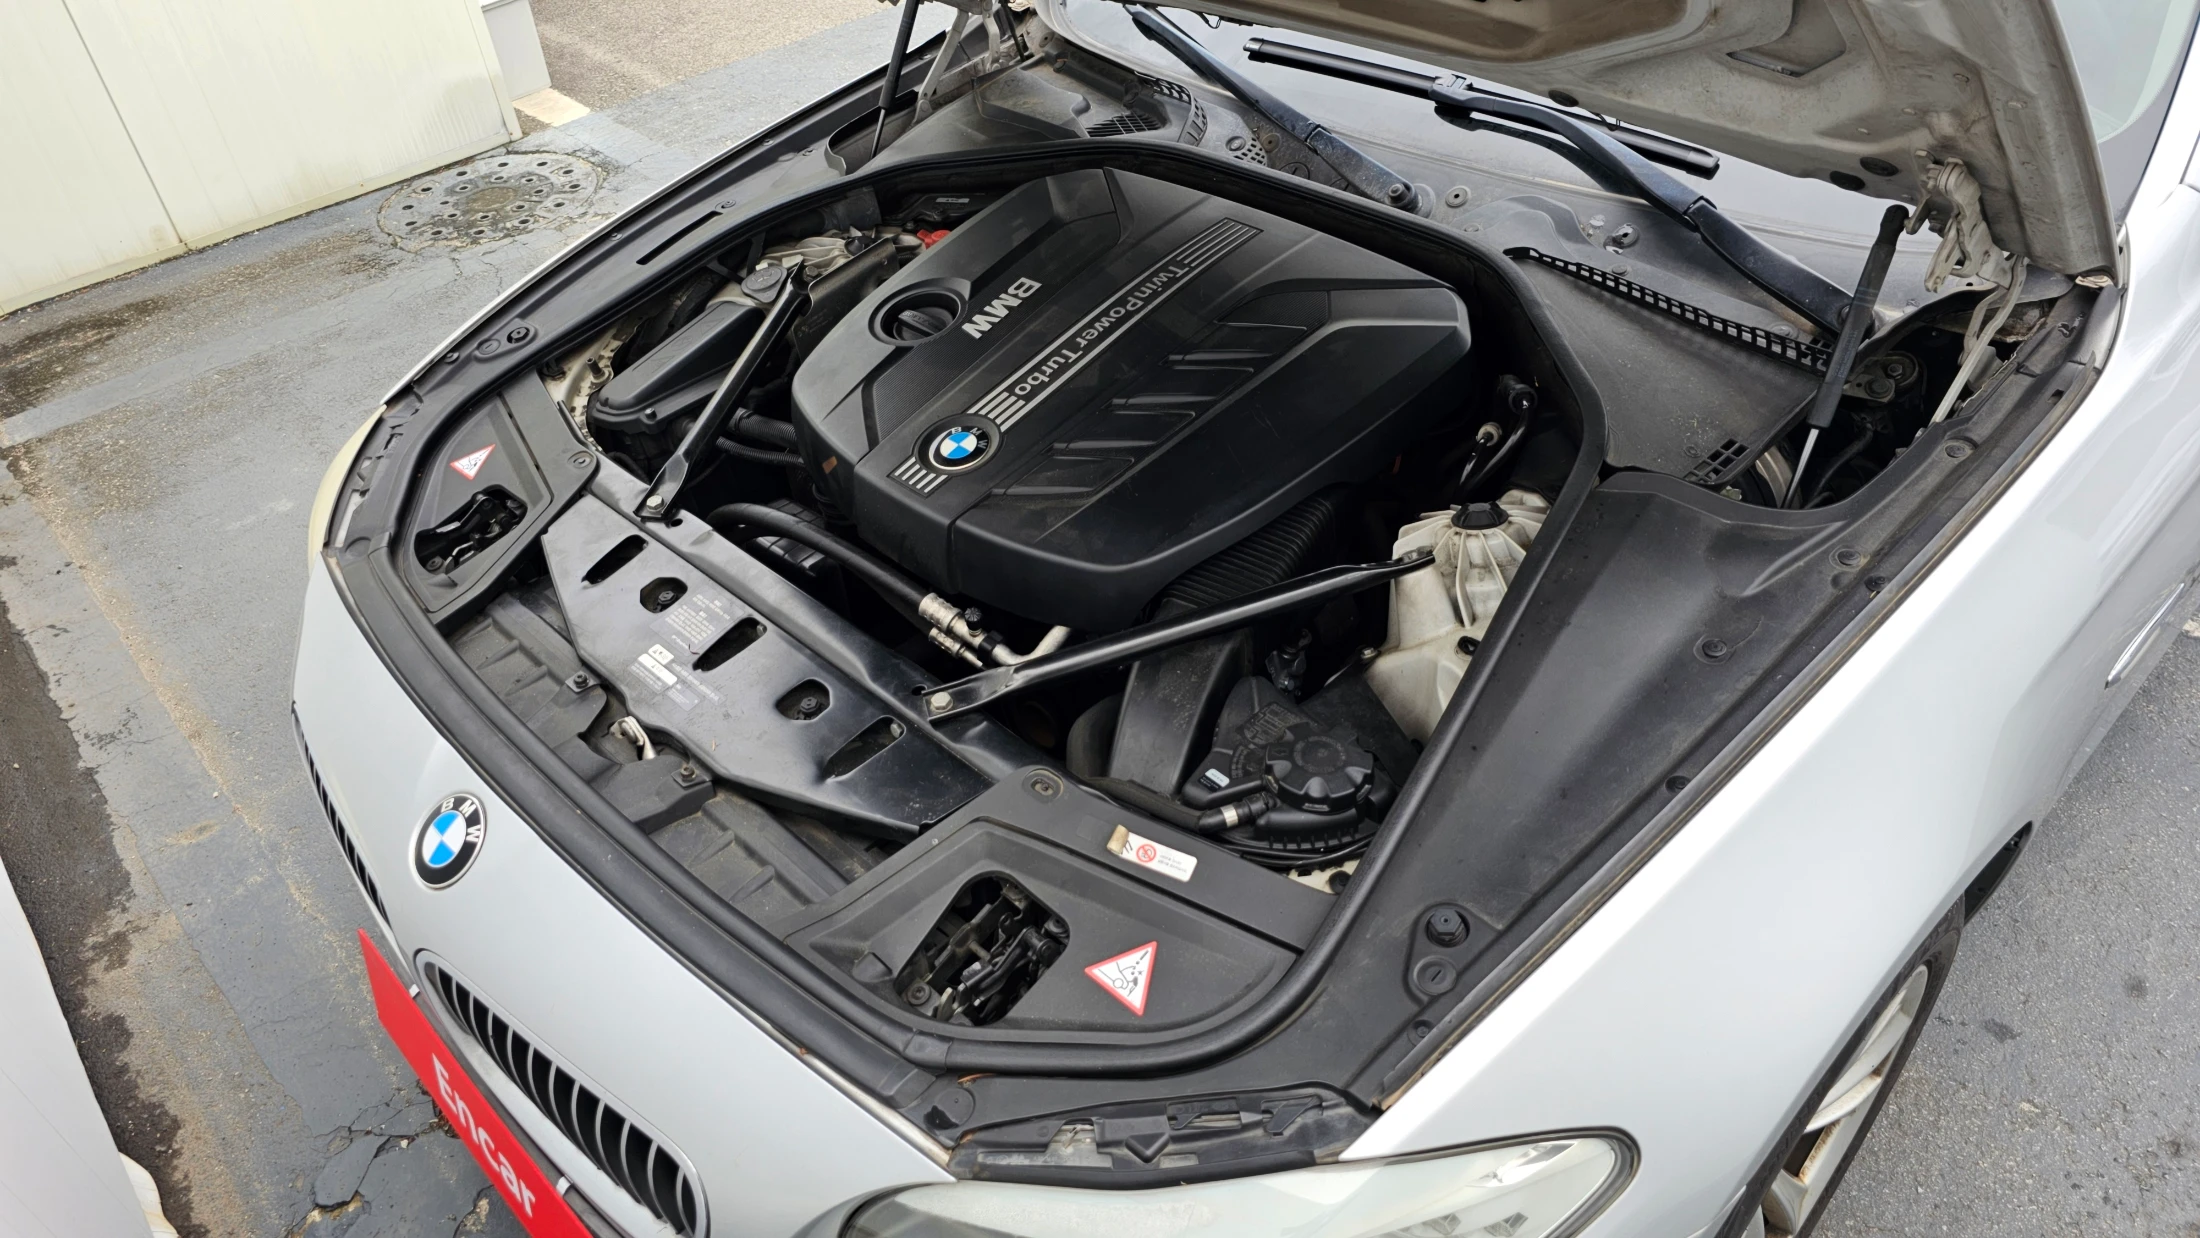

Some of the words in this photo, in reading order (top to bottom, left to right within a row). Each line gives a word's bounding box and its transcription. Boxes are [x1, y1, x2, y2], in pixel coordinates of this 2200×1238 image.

[962, 277, 1042, 339] BMW
[1015, 349, 1083, 396] Turbo
[951, 426, 988, 449] BMW
[440, 797, 482, 842] BMW
[432, 1052, 536, 1218] Encar
